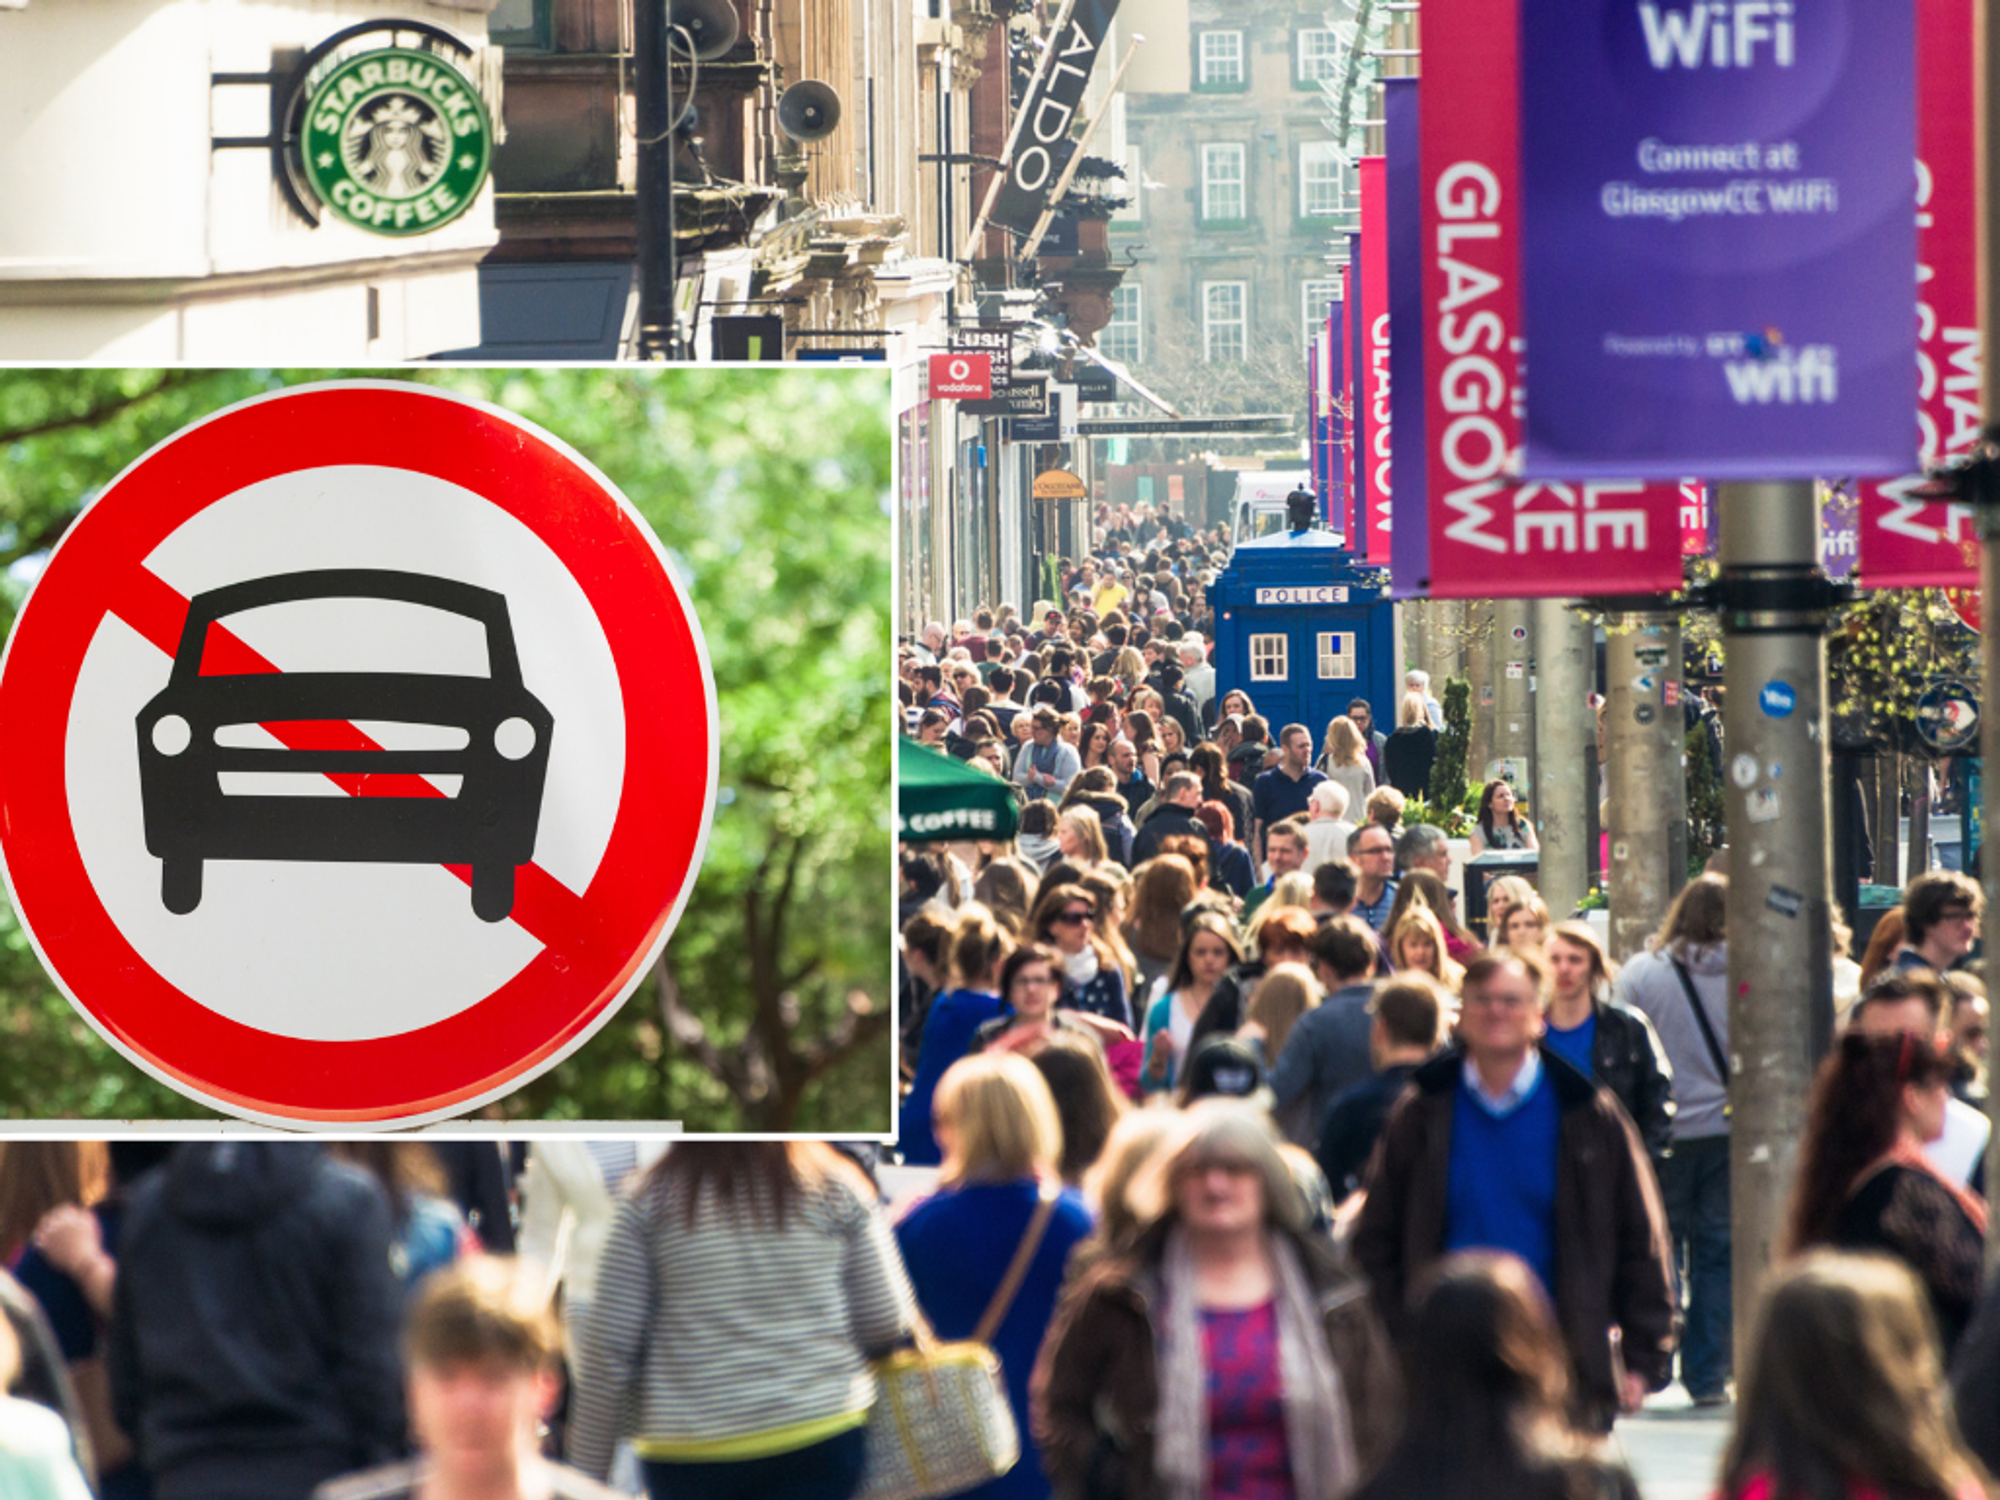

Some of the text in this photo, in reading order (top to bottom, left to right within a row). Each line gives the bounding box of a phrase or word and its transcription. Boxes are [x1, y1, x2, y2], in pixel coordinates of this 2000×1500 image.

[1639, 0, 1794, 67] WiFi
[314, 58, 480, 138] STARBUCKS
[1015, 19, 1095, 191] ALDO
[1638, 139, 1799, 172] Connect at
[331, 179, 459, 228] COFFEE
[1765, 178, 1839, 214] WiFi
[953, 332, 1009, 348] LUSH
[1436, 161, 1508, 553] GLASGOW
[937, 382, 983, 393] vodafone
[1724, 341, 1838, 404] wifi
[1261, 587, 1341, 603] POLICE
[909, 808, 997, 833] COFFEE
